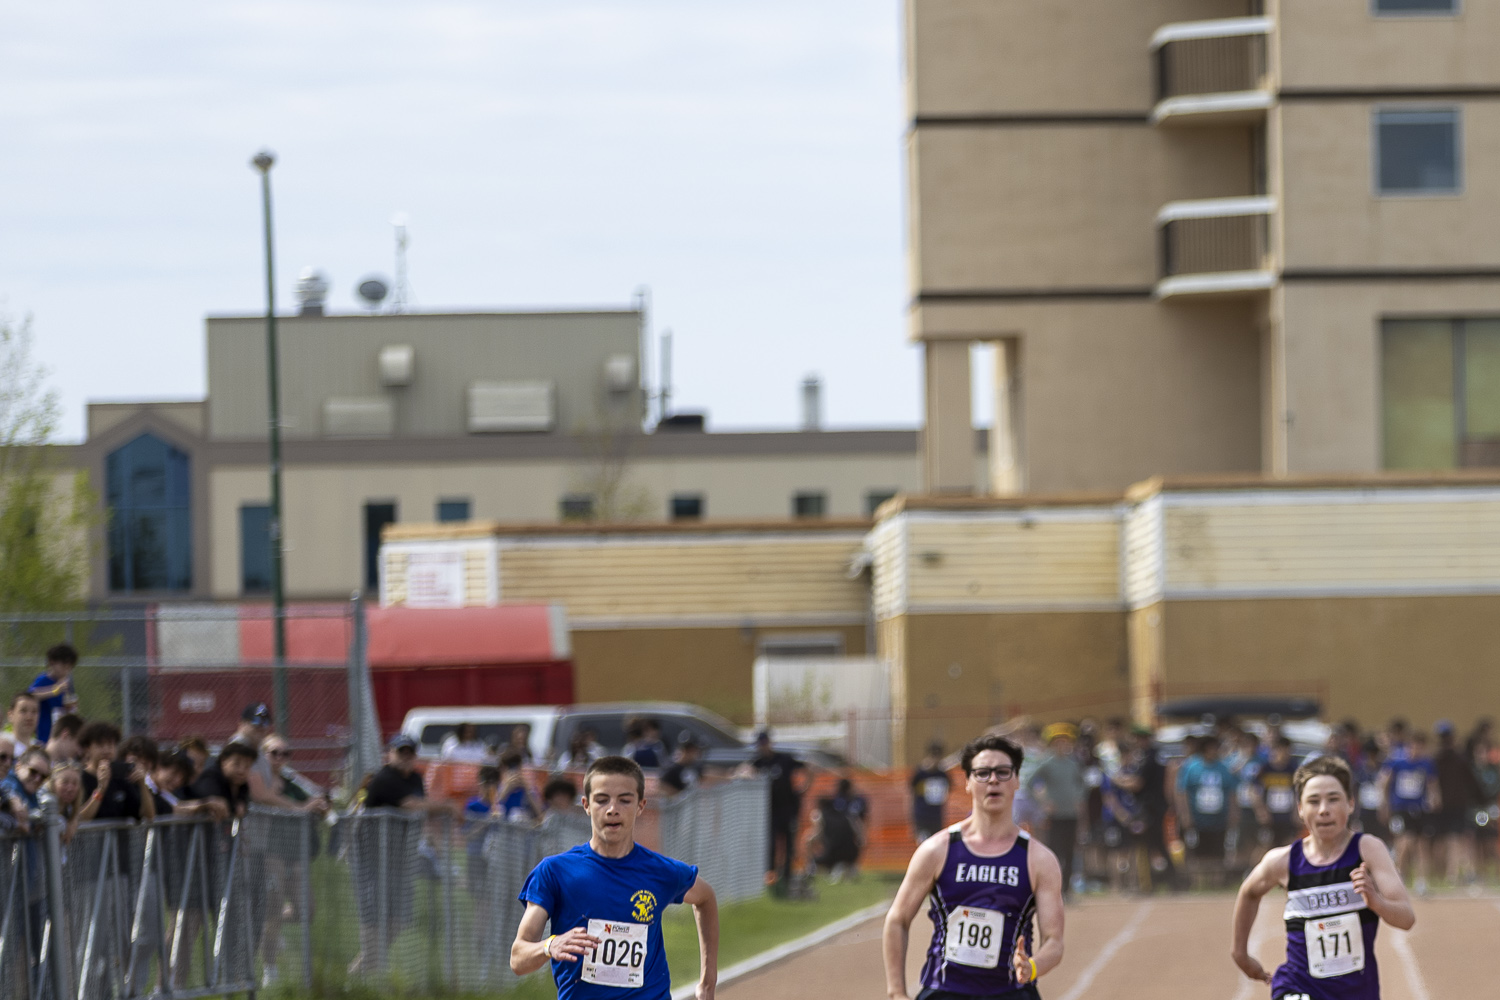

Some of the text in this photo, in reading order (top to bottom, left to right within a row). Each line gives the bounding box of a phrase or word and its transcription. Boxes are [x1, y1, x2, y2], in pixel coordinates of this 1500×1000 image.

[955, 863, 1019, 887] EAGLES
[1307, 889, 1349, 910] DJSS
[958, 921, 992, 949] 198
[1316, 930, 1351, 959] 171
[591, 938, 643, 968] 1026
